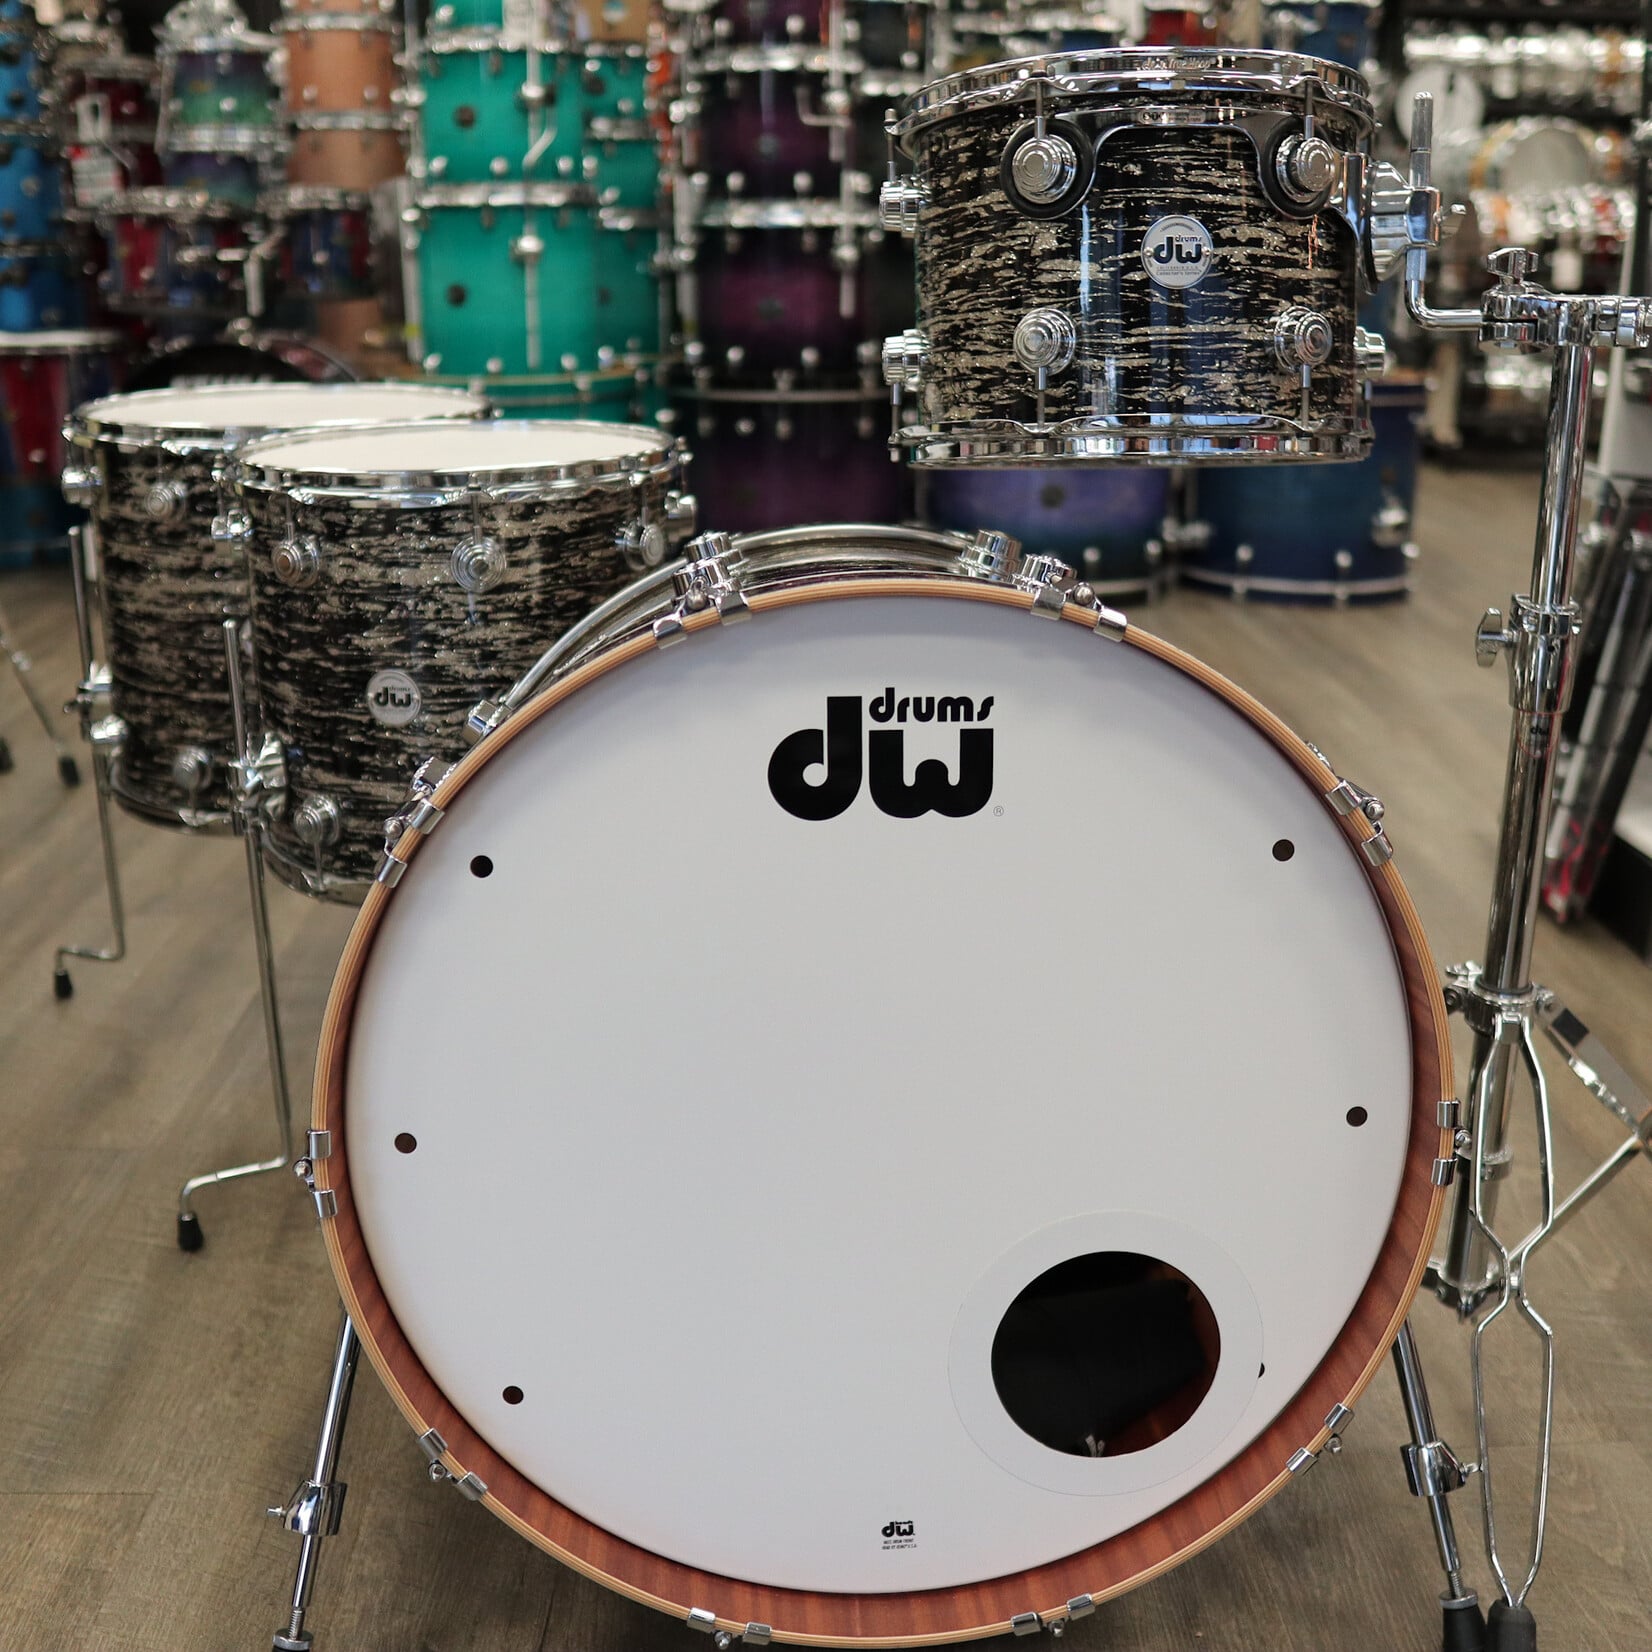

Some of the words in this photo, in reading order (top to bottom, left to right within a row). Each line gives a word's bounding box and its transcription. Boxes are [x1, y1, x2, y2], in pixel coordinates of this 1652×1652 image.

[1174, 234, 1202, 242] drums
[1153, 237, 1202, 264] dw
[374, 686, 412, 707] dw
[868, 687, 995, 723] drums
[767, 695, 994, 822] dw
[881, 1521, 914, 1538] dw
